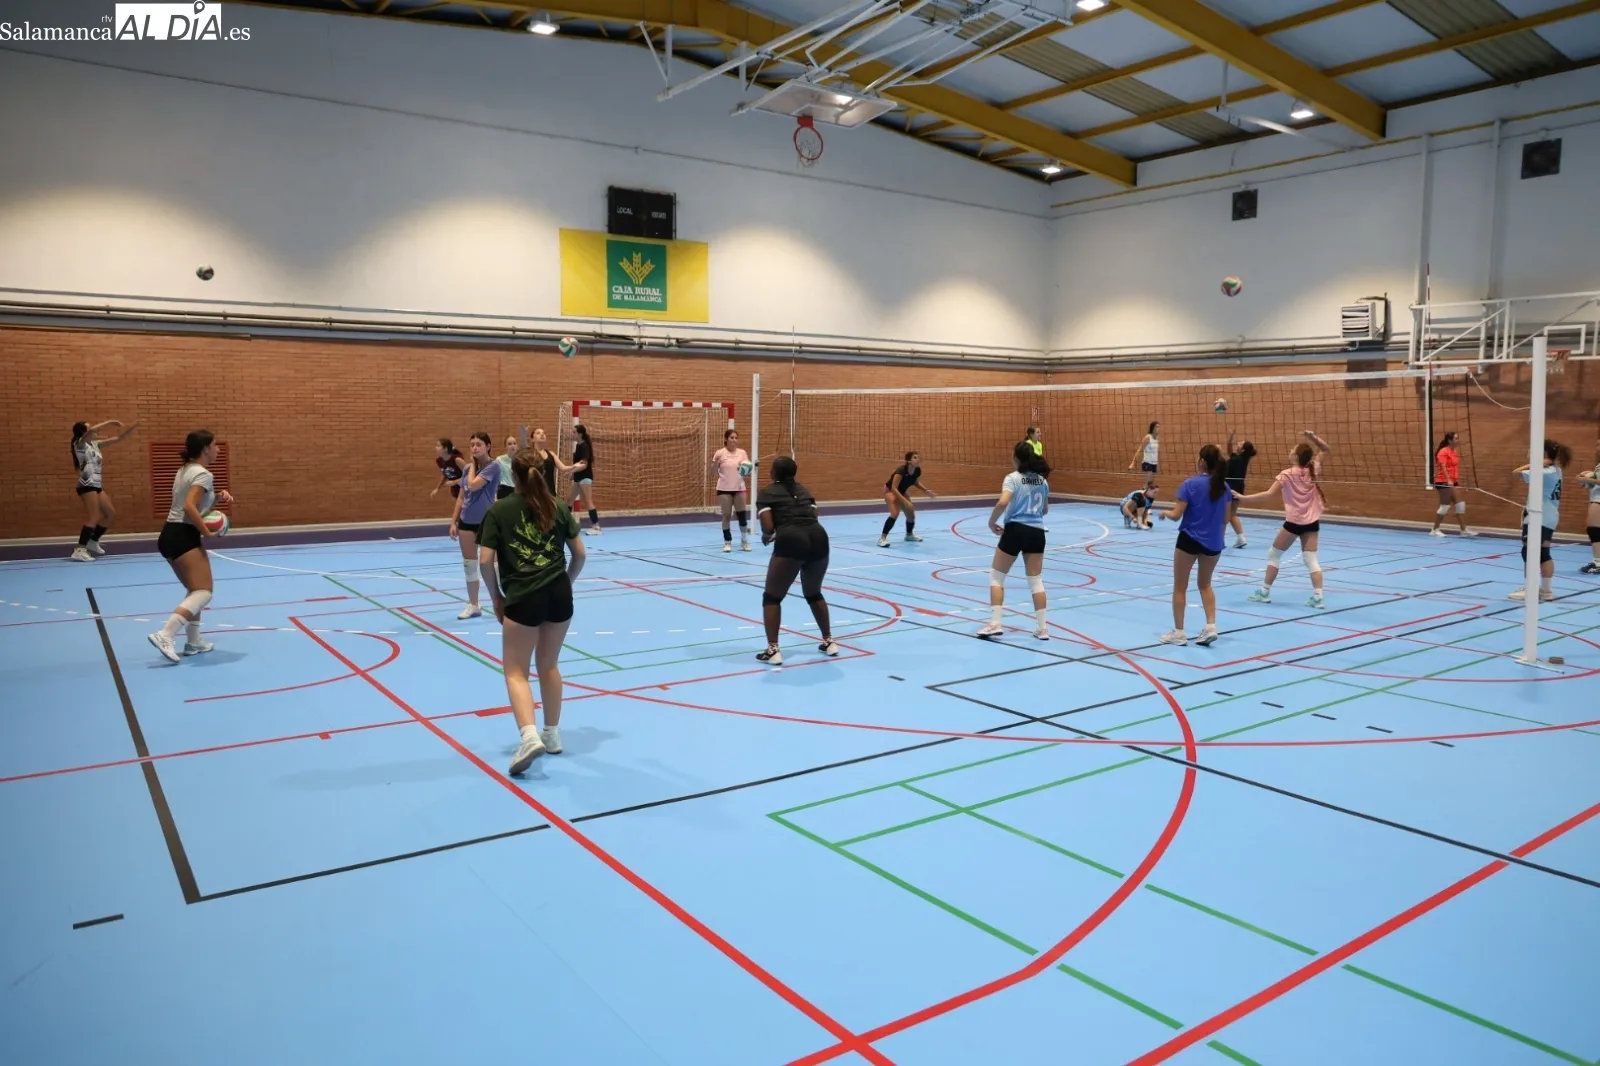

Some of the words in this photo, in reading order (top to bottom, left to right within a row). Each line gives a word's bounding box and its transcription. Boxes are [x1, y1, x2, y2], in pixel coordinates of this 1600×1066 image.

[612, 285, 633, 294] CAJA
[634, 286, 662, 296] RURAL
[1024, 492, 1043, 514] 12
